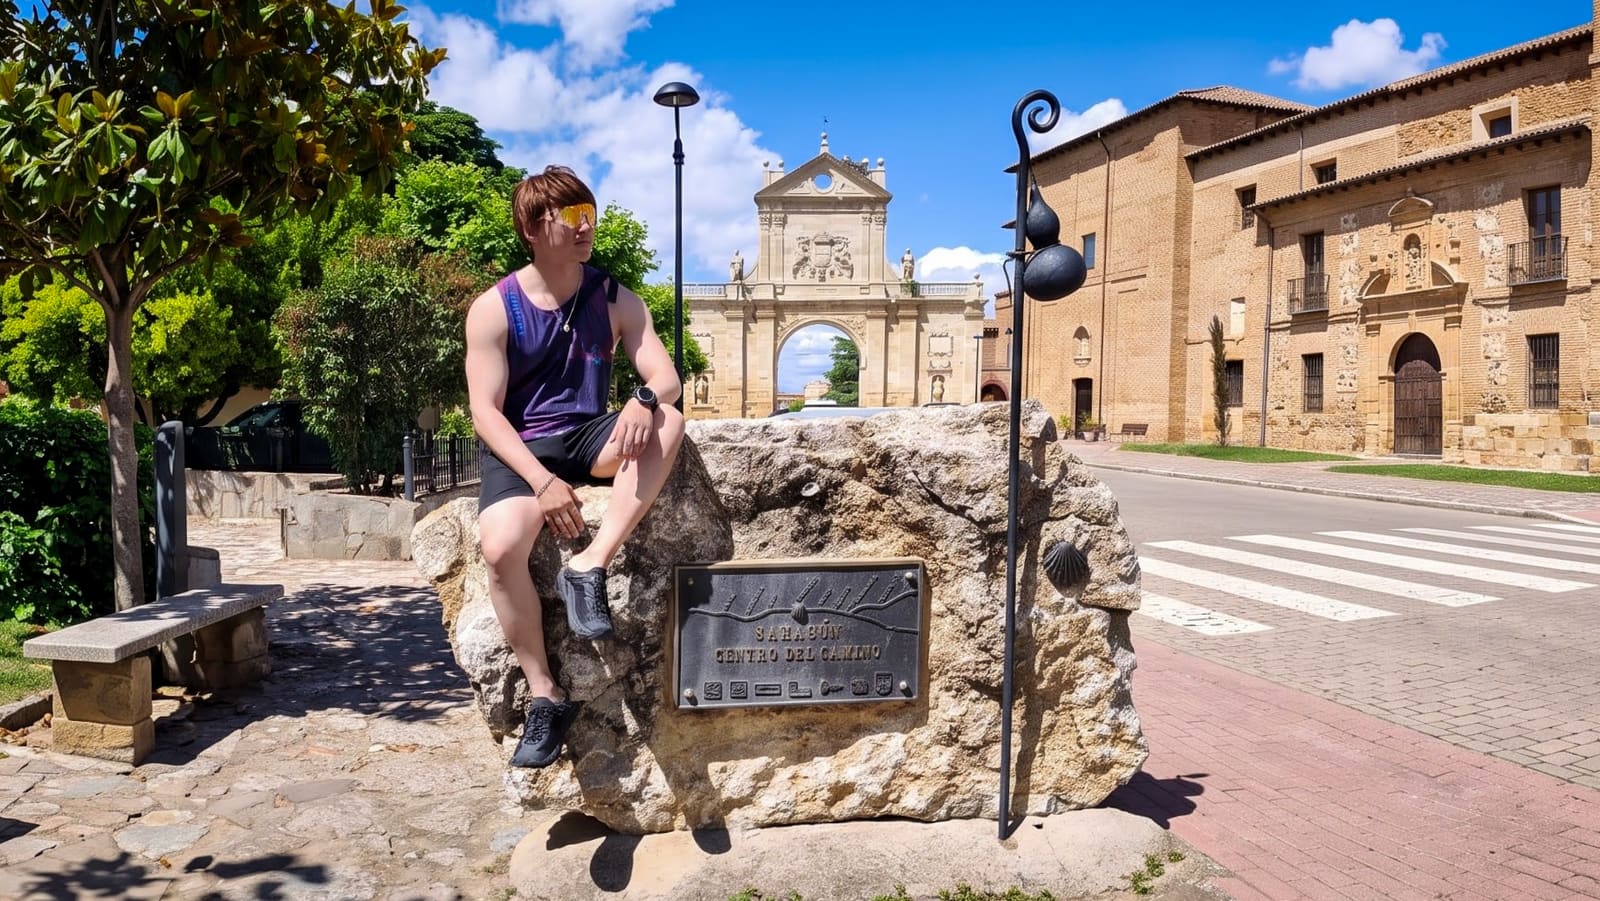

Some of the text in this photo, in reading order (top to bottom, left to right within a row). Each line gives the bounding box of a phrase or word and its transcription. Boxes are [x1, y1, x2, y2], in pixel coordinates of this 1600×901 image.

[715, 643, 882, 664] CENTRO DEL CAMINO
